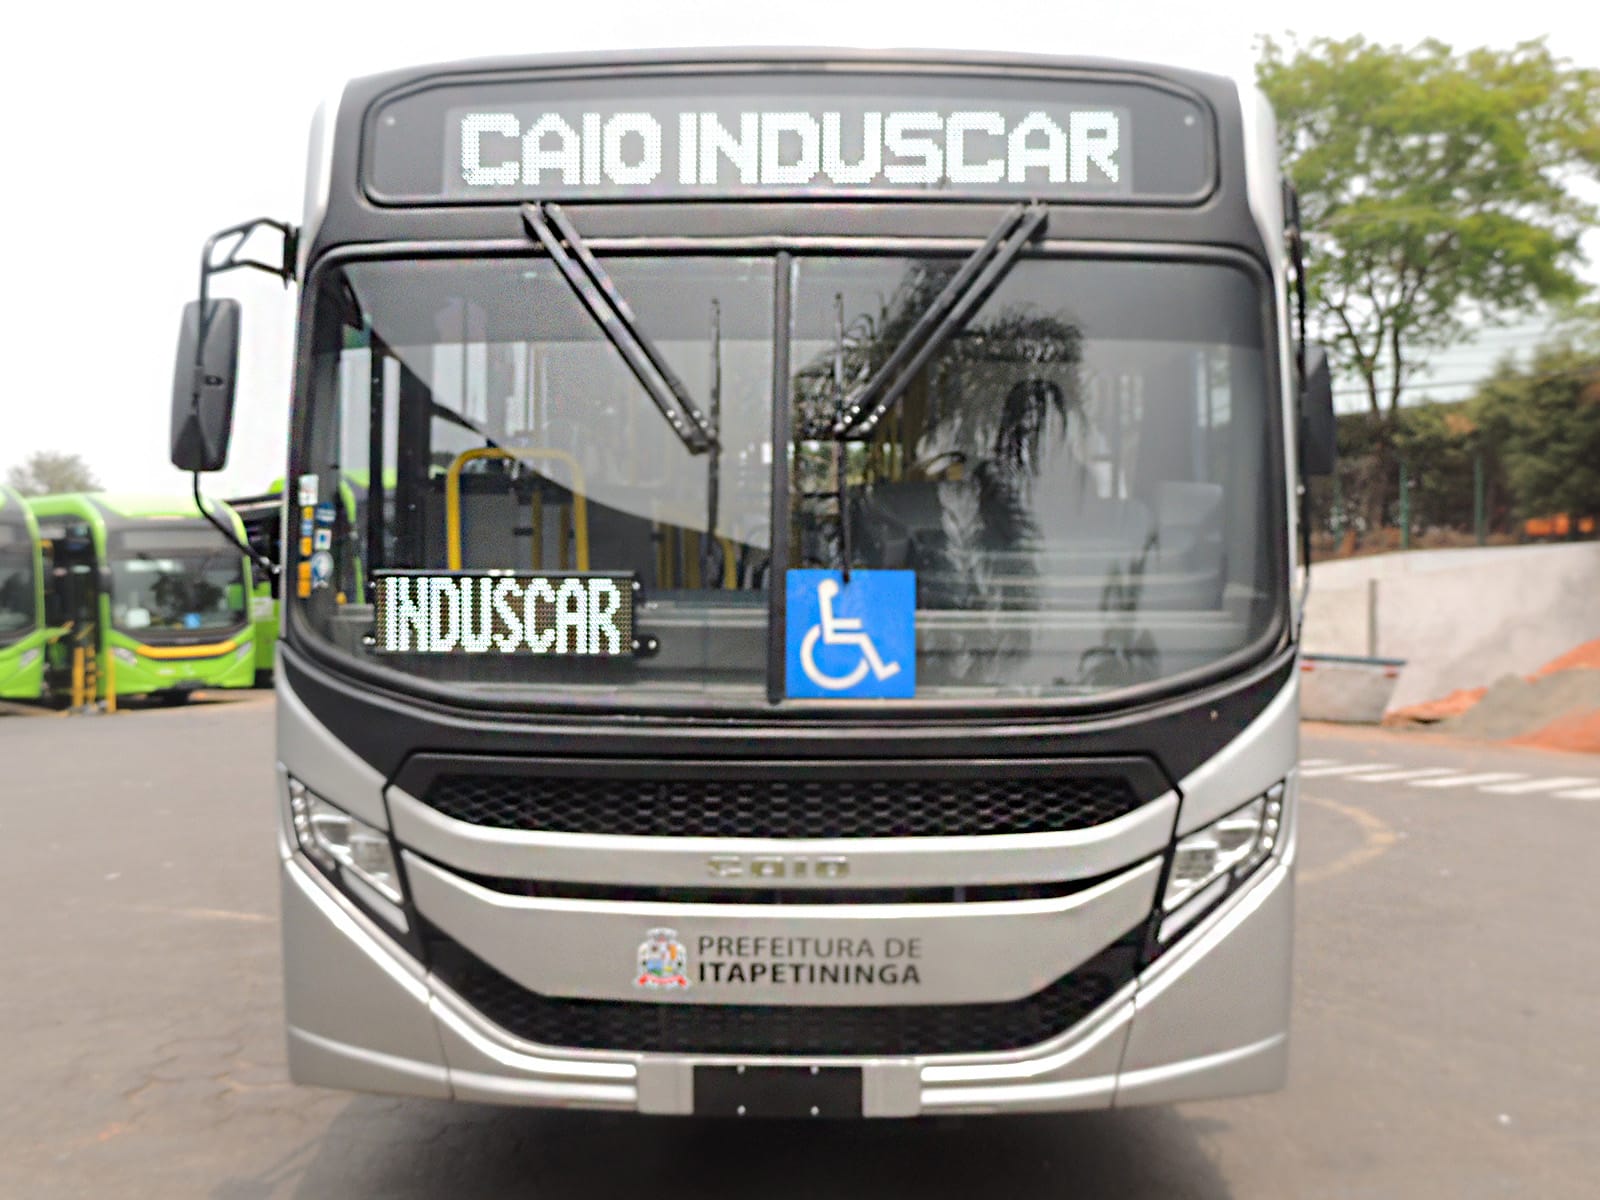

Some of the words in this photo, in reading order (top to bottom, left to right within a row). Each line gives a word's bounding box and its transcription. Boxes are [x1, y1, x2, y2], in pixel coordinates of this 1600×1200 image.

[461, 112, 662, 185] CAIO
[678, 111, 1119, 184] INDUSCAR
[385, 576, 621, 655] INDUSCAR
[698, 935, 875, 959] PREFEITURA
[884, 937, 922, 959] DE
[699, 961, 922, 985] ITAPETININGA
